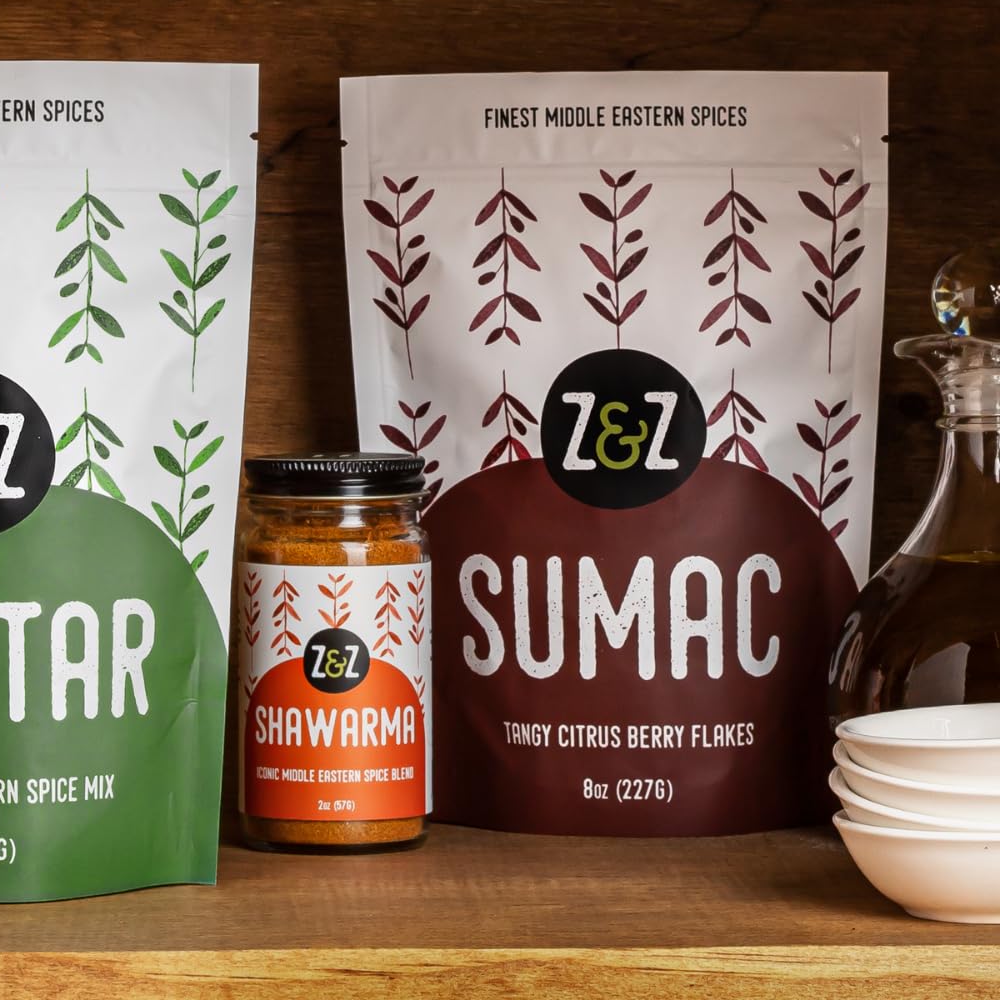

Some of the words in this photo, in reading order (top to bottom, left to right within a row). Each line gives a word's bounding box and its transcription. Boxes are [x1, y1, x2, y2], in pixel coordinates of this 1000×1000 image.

[44, 100, 104, 122] SPICES
[485, 107, 538, 128] FINEST
[546, 106, 605, 127] MIDDLE
[613, 106, 684, 126] EASTERN
[691, 106, 746, 126] SPICES
[562, 392, 679, 470] Z&Z
[460, 554, 781, 680] SUMAC
[312, 645, 359, 678] Z&Z
[257, 706, 414, 747] SHAWARMA
[504, 722, 551, 747] TANGY
[559, 725, 620, 748] CITRUS
[628, 725, 684, 748] BERRY
[692, 723, 753, 747] FLAKES
[256, 766, 280, 780] ICONIC
[281, 767, 315, 783] MIDDLE
[317, 768, 361, 783] EASTERN
[363, 767, 389, 782] SPICE
[390, 765, 414, 780] BLEND
[27, 777, 78, 804] SPICE
[85, 774, 114, 800] MIX
[584, 778, 608, 799] 8oz
[617, 779, 673, 802] (227G)
[317, 799, 330, 810] 2oz
[333, 799, 355, 812] (57G)
